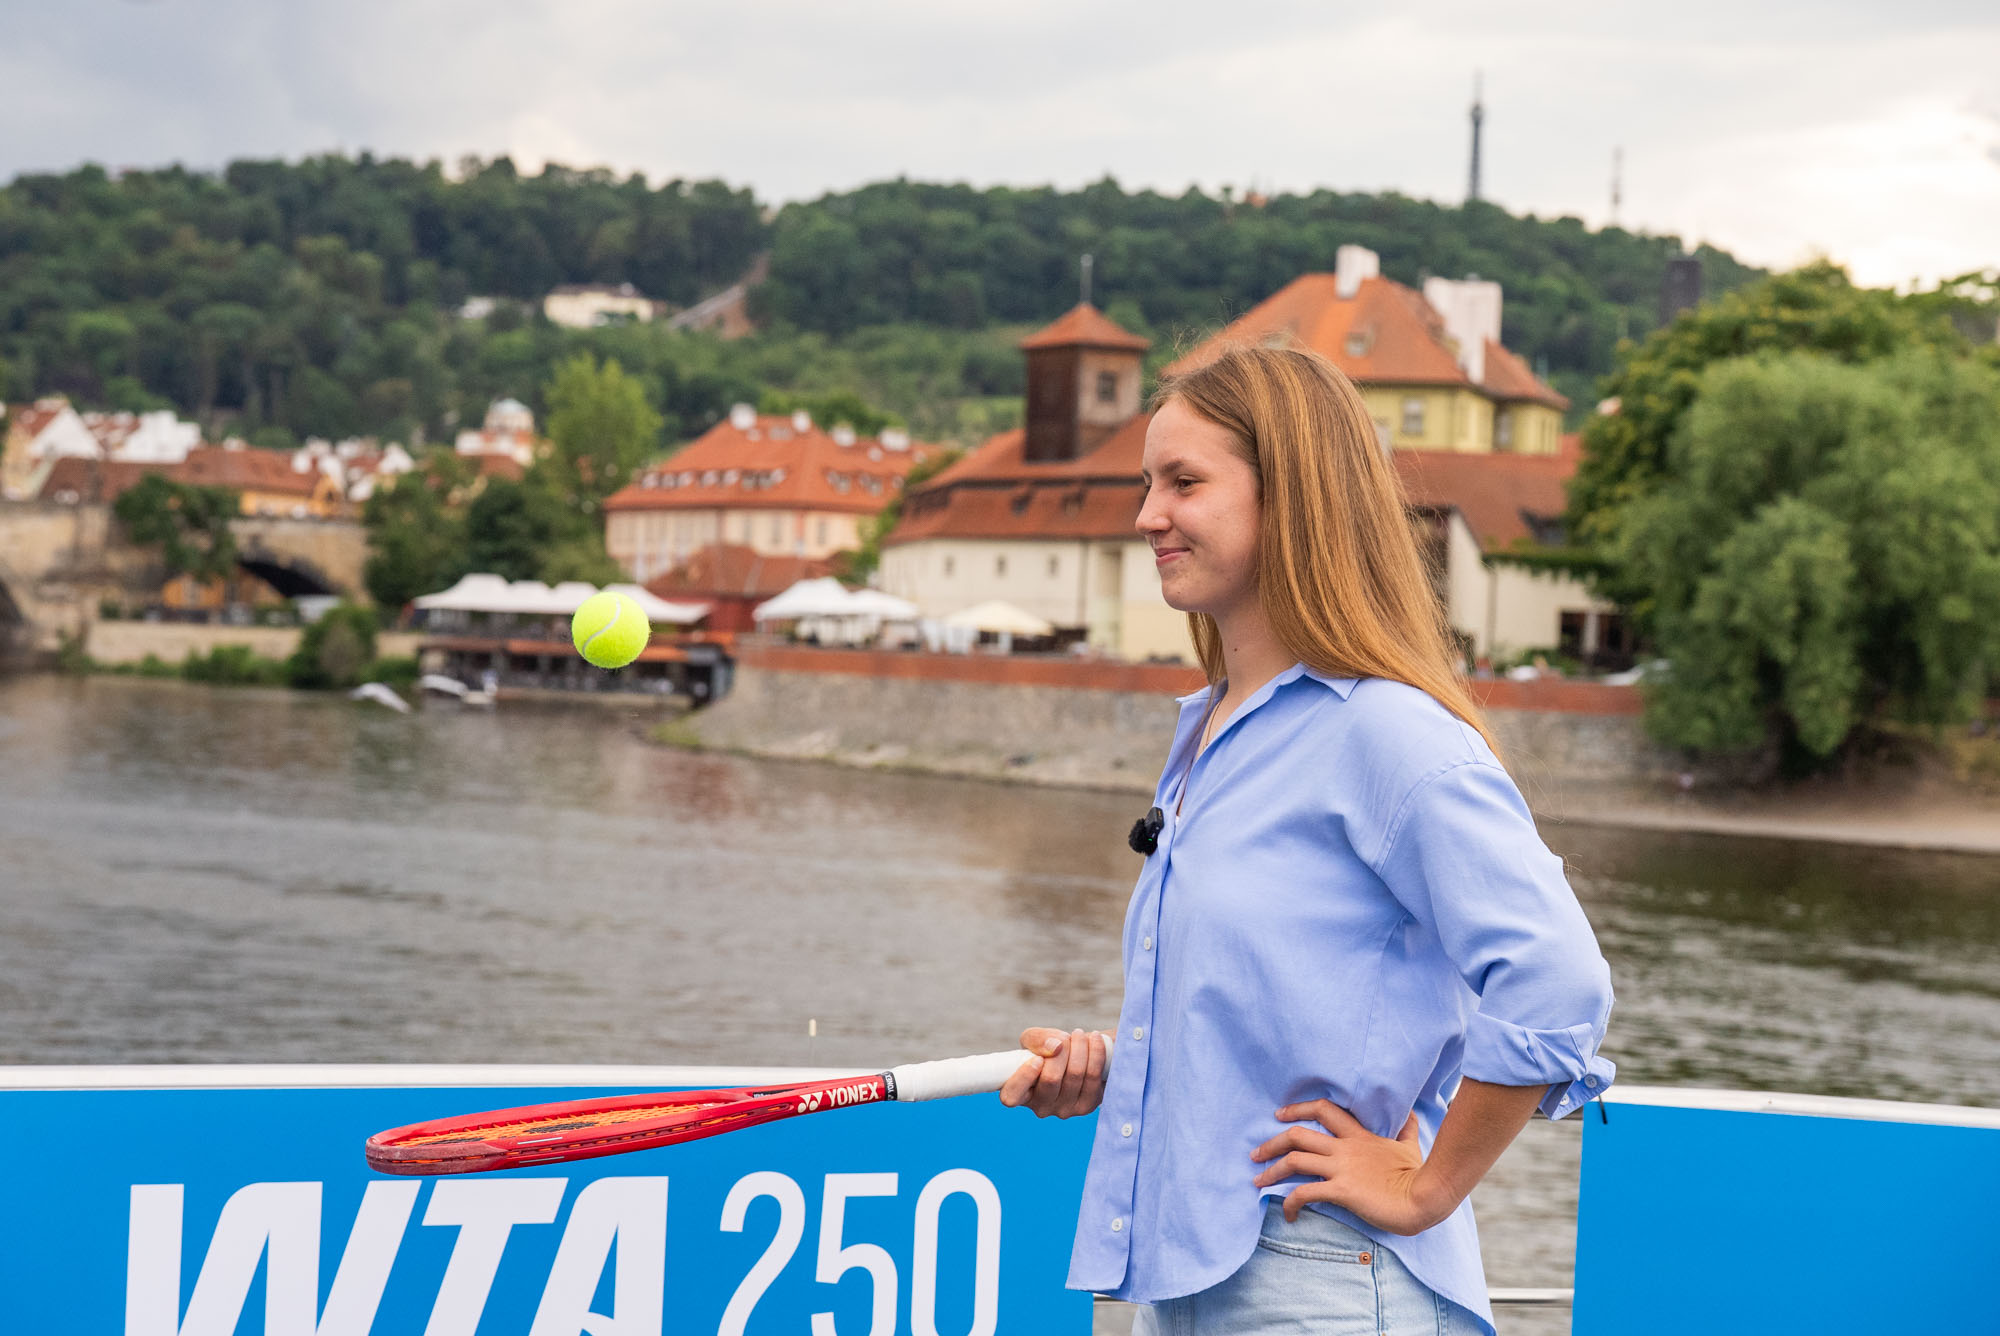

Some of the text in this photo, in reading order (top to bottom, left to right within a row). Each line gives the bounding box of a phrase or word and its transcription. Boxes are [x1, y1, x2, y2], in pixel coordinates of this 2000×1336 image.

[826, 1081, 879, 1107] YONEX
[125, 1168, 1002, 1336] WTA 250
